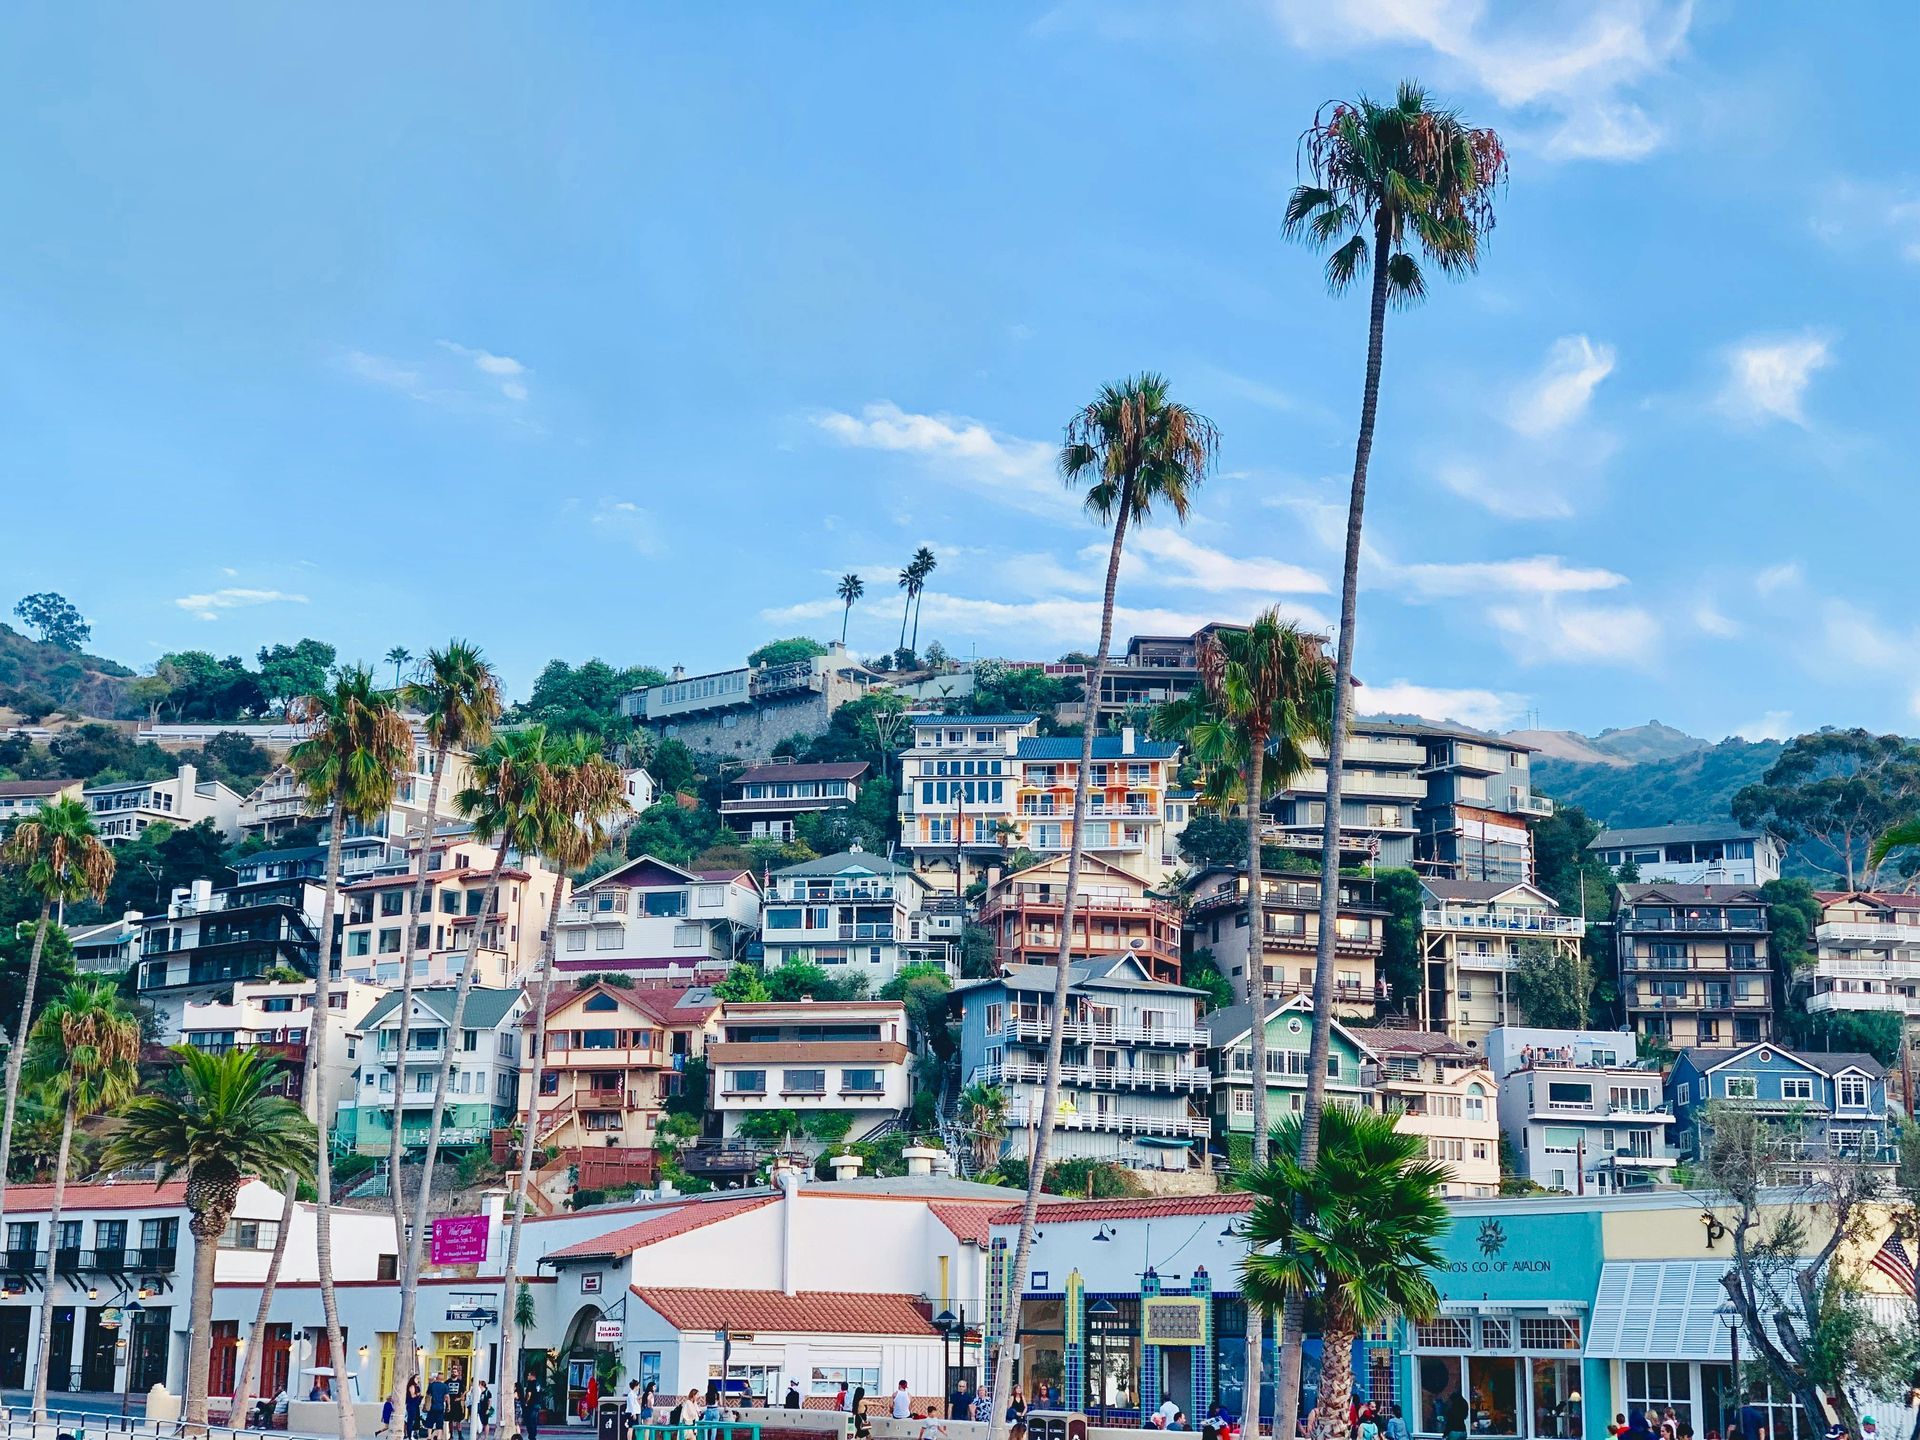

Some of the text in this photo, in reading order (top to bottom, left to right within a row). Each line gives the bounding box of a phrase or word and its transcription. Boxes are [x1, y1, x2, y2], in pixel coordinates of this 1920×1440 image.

[1472, 1261, 1491, 1273] CO.
[1494, 1261, 1509, 1273] OF
[1512, 1260, 1551, 1272] AVALON
